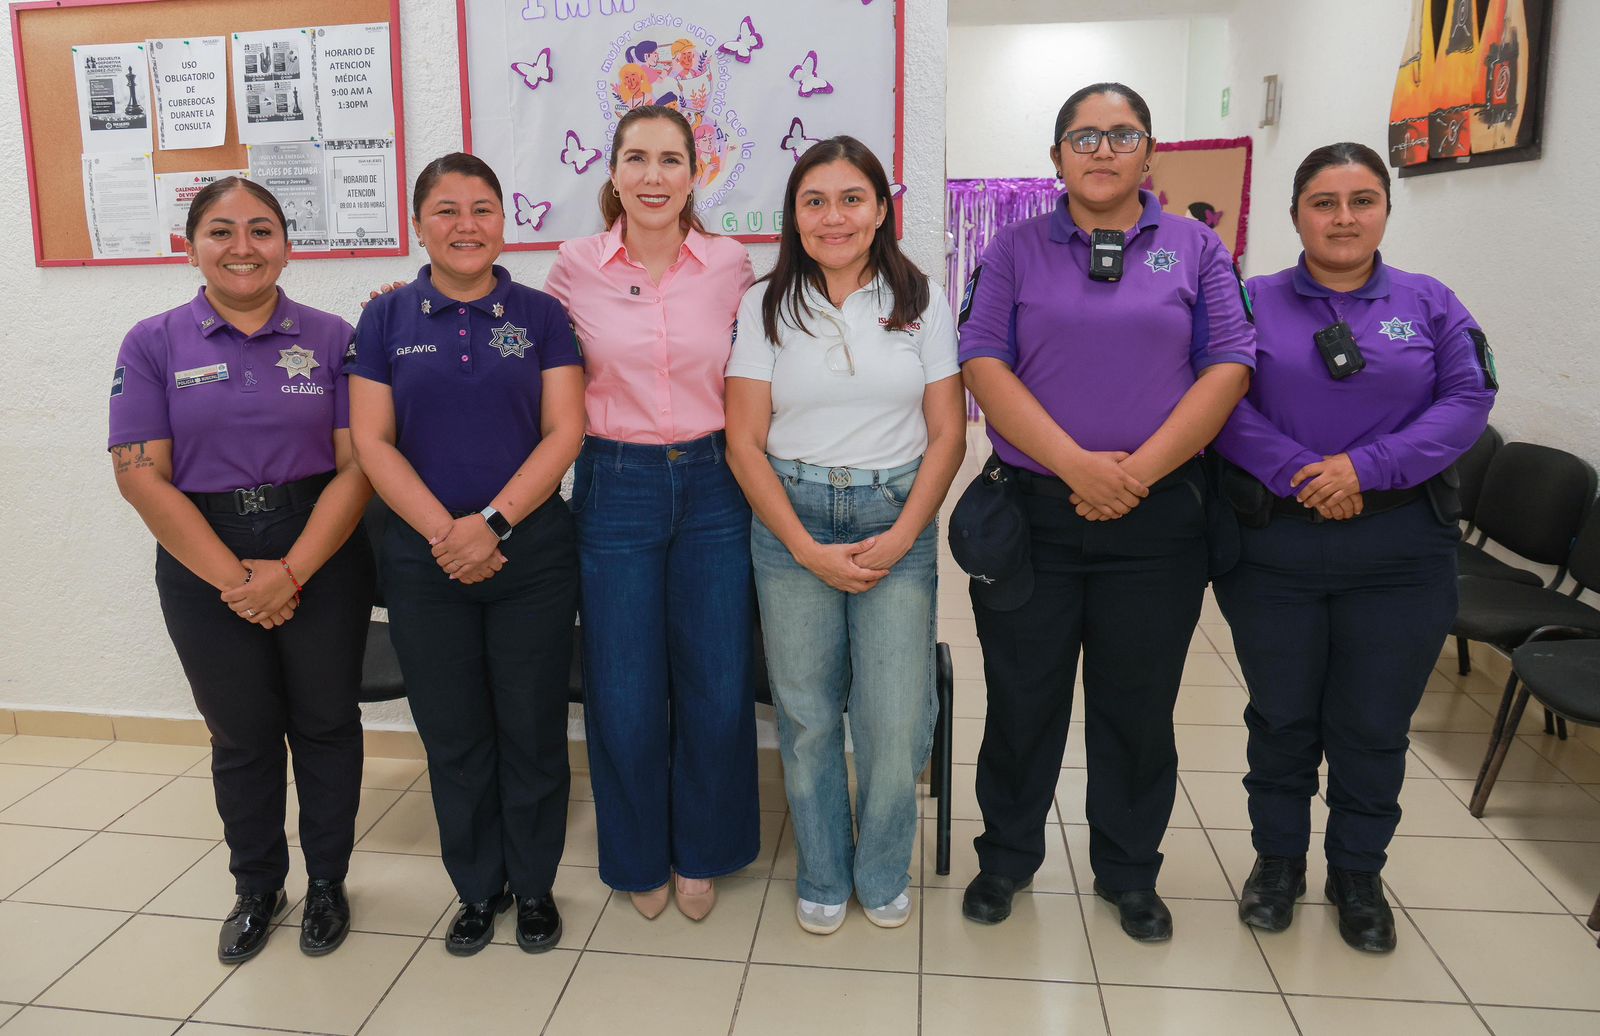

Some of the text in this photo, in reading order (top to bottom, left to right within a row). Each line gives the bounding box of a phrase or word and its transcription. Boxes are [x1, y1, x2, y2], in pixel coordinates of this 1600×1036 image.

[633, 13, 683, 32] existe
[686, 23, 717, 46] una
[324, 47, 375, 57] HORARIO DE
[601, 31, 632, 73] mujer
[181, 61, 197, 70] USO
[329, 60, 371, 70] ATENCION
[164, 72, 215, 83] OBLIGATORIO
[335, 73, 367, 83] MÉDICA
[186, 86, 196, 94] DE
[331, 86, 373, 97] 9:00 AM A
[168, 96, 215, 107] CUBREBOCAS
[338, 100, 369, 109] 1:30PM
[596, 80, 612, 120] cada
[170, 109, 215, 119] DURANTE LA
[174, 121, 212, 131] CONSULTA
[725, 109, 748, 138] que
[741, 141, 755, 160] la
[257, 167, 282, 176] CLASES
[282, 167, 292, 176] DE
[343, 174, 377, 184] HORARIO DE
[347, 188, 376, 198] ATENCION
[396, 344, 437, 356] GEAVIG
